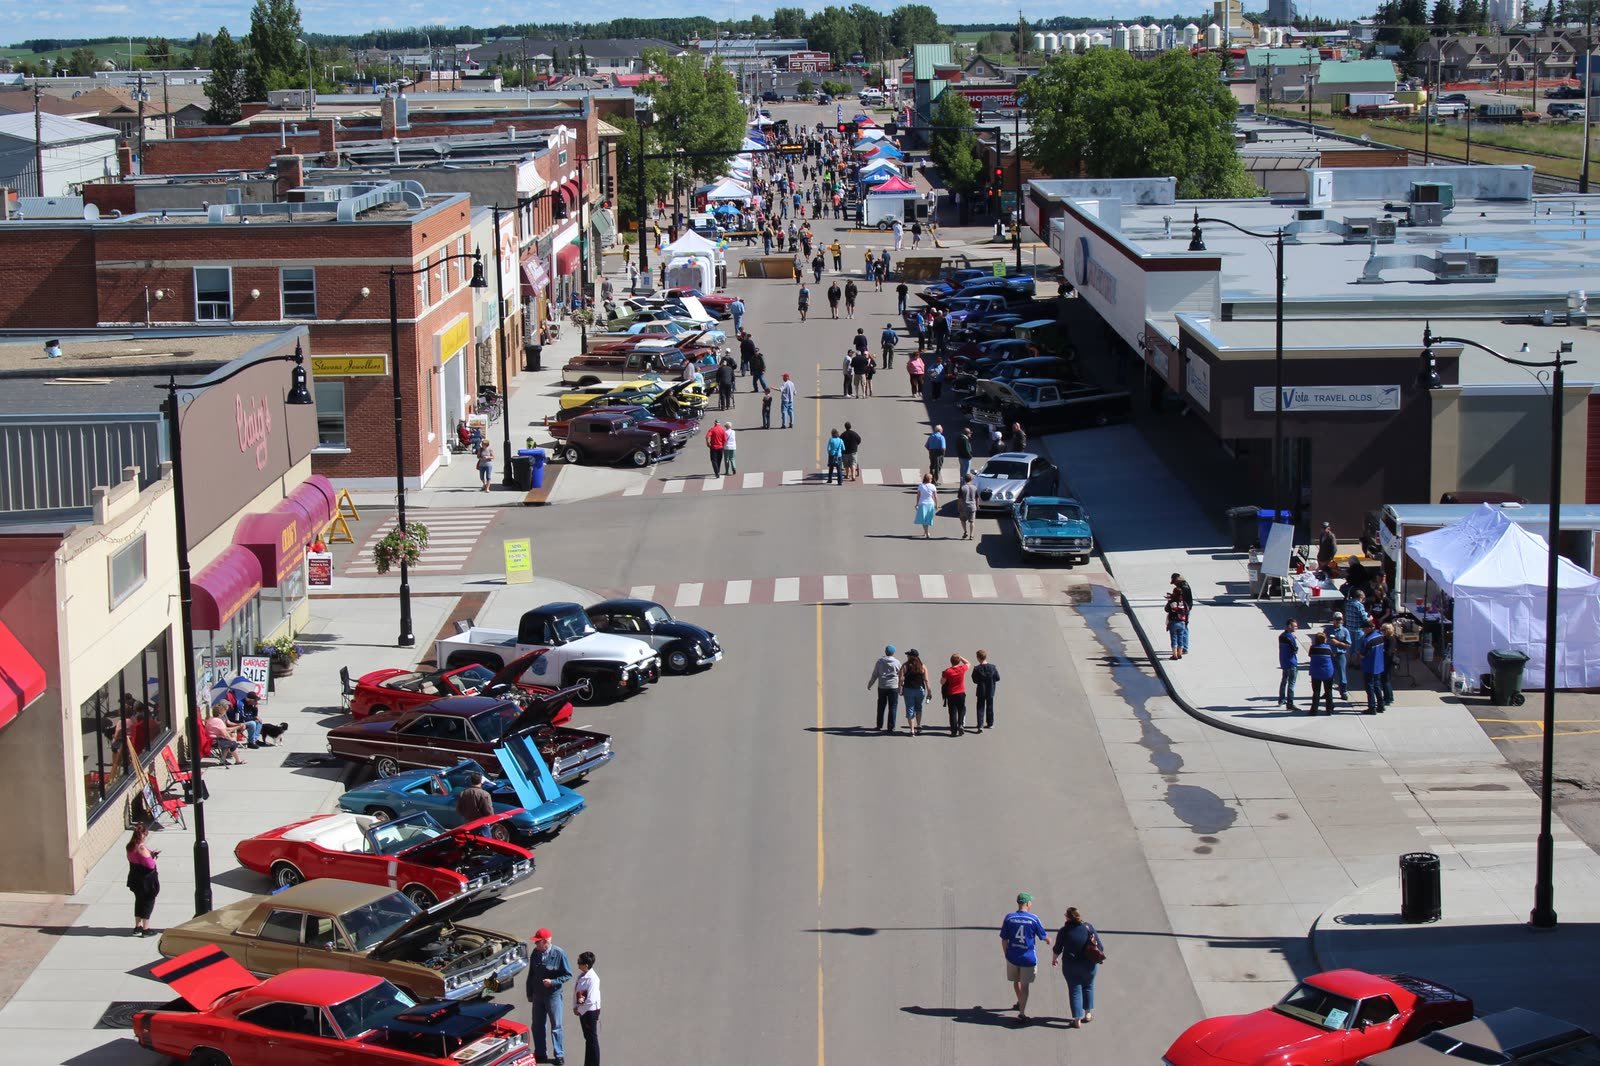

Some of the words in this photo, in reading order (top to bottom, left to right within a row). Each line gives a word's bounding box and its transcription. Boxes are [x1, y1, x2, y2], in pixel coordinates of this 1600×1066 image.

[1283, 388, 1309, 408] Vista
[1313, 394, 1346, 402] TRAVEL
[1349, 394, 1373, 402] OLDS
[243, 658, 269, 668] GARAGE
[243, 667, 267, 682] SALE
[1015, 924, 1025, 943] 4
